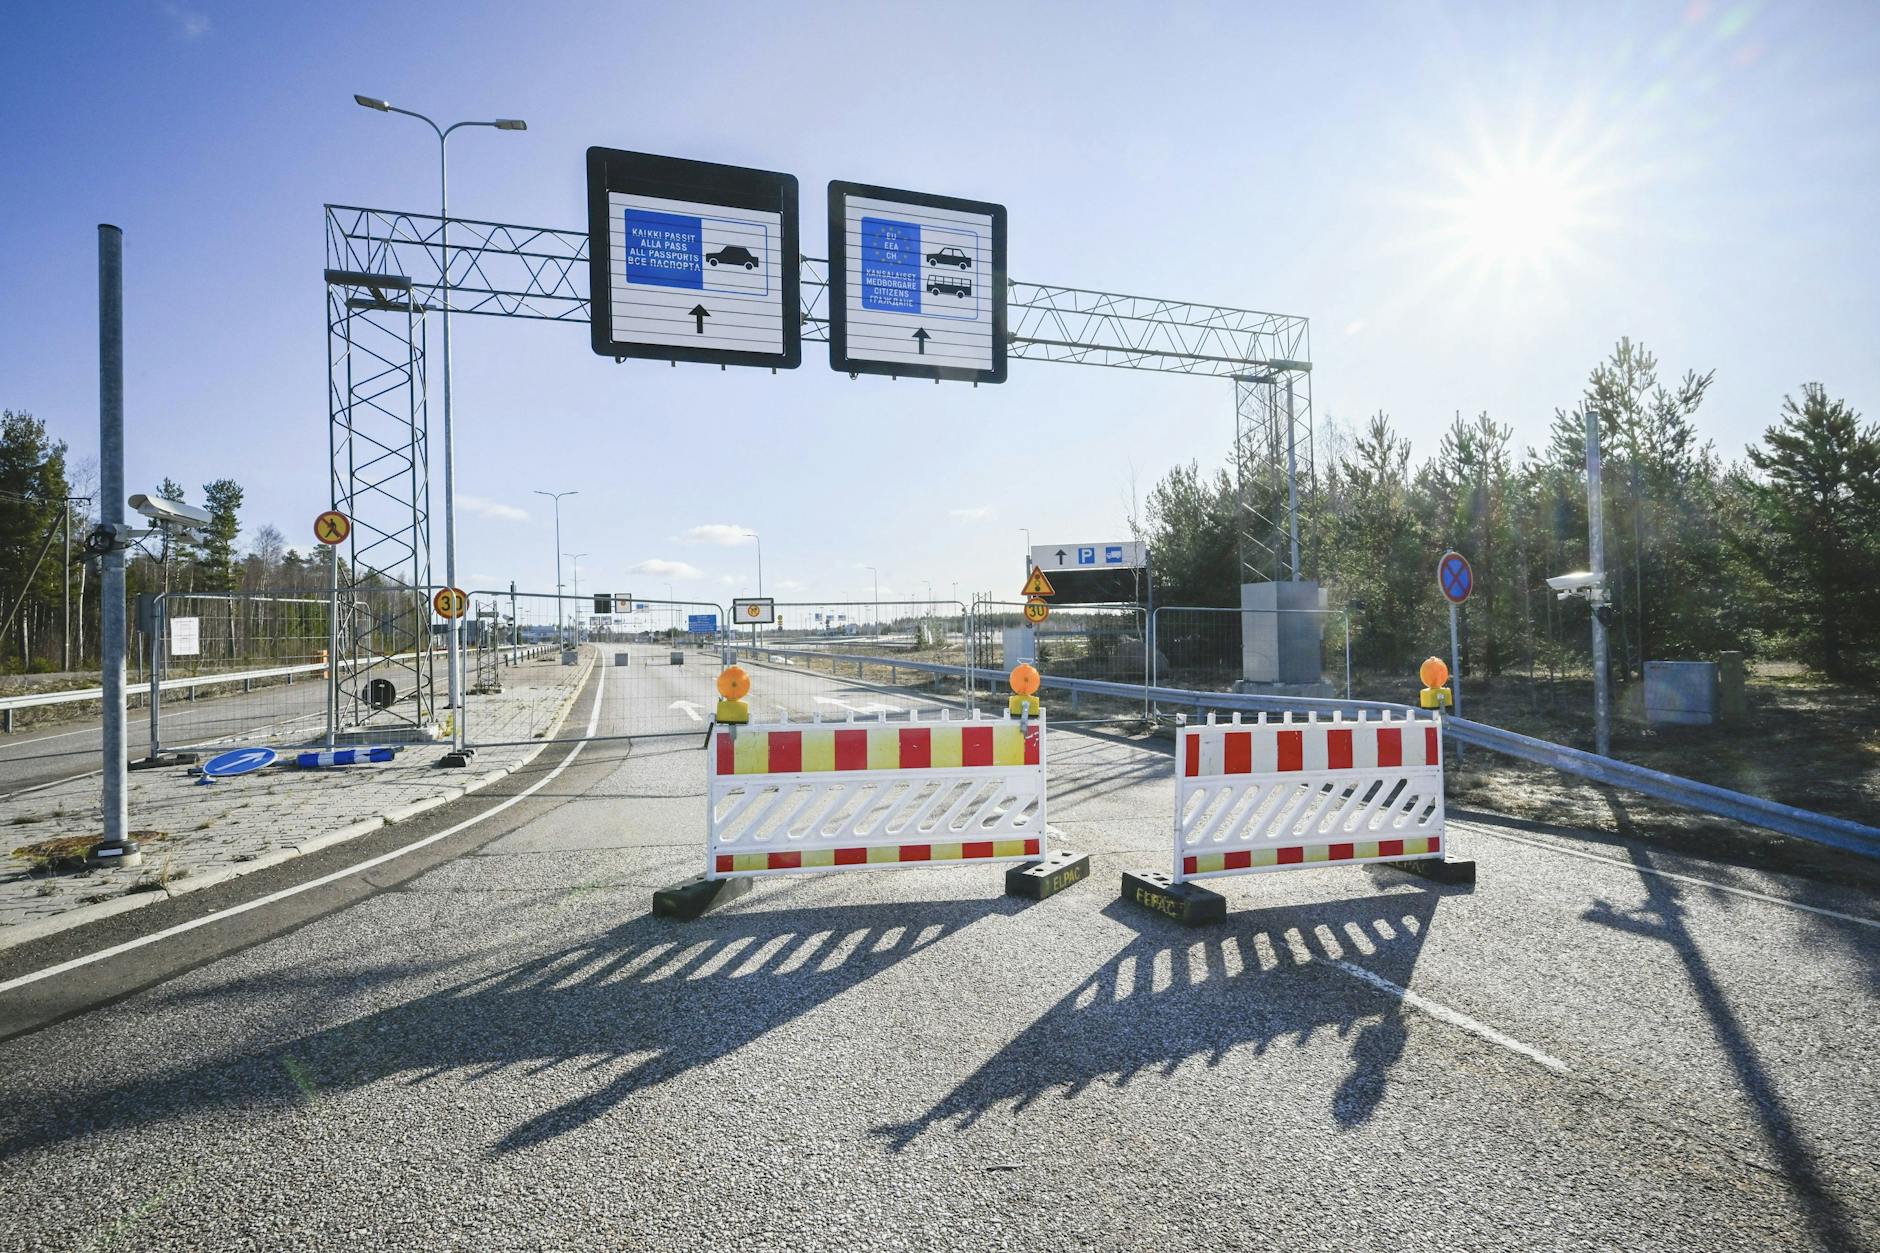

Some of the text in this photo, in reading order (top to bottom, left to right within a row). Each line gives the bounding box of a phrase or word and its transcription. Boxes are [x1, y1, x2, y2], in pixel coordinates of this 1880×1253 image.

[632, 228, 696, 243] KAIKKI PASSIT
[886, 232, 897, 240] EU
[640, 239, 688, 252] ALLA PASS
[884, 242, 899, 250] EEA
[630, 248, 699, 262] ALL PASSPORTS
[886, 252, 897, 260] CH
[627, 256, 701, 272] ВСЕ ПАСПОРТА
[866, 268, 917, 282] KANSALAISET
[866, 278, 917, 290] MEDBORGARE
[874, 287, 910, 298] CITIZENS
[1081, 549, 1093, 563] P
[441, 595, 463, 611] 30
[1028, 604, 1046, 618] 30
[1053, 867, 1081, 891] ELPAC
